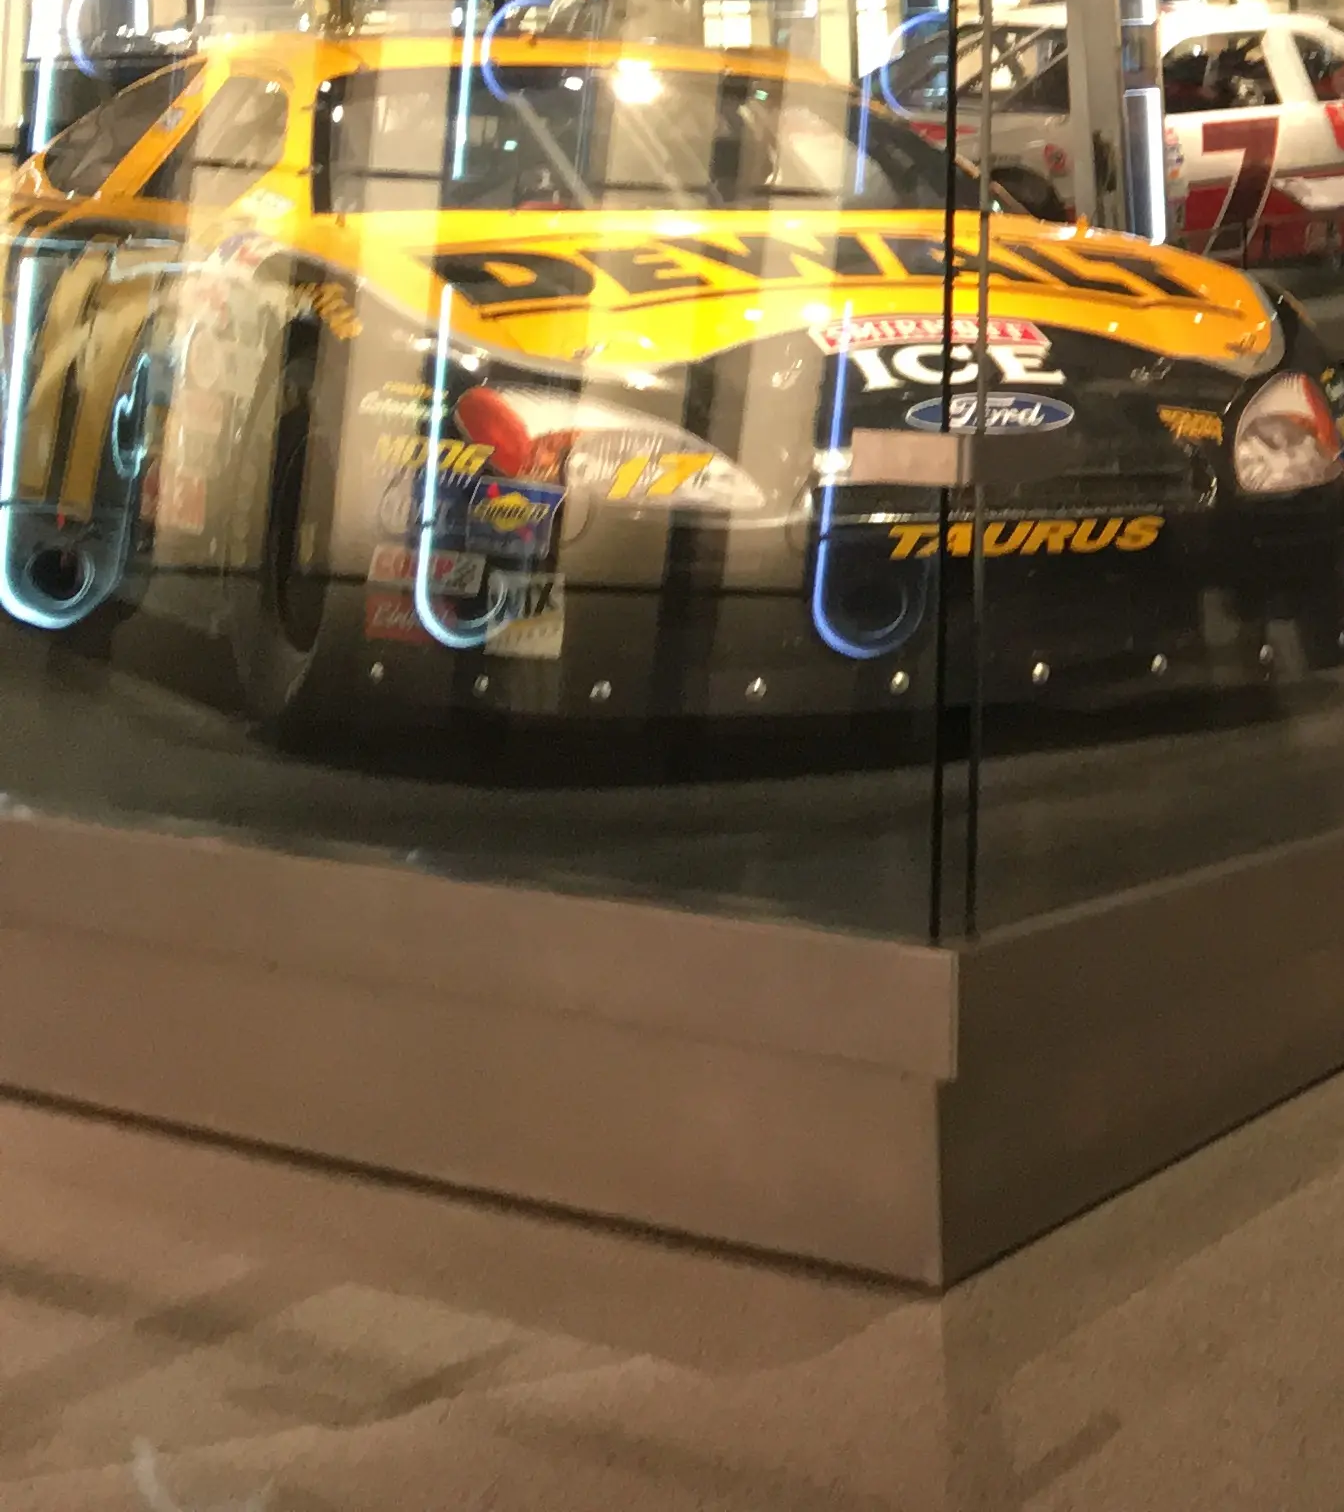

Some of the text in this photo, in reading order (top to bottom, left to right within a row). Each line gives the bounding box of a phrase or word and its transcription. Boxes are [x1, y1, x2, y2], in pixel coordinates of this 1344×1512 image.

[1202, 116, 1281, 256] 7
[851, 344, 1067, 393] ICE
[373, 434, 497, 476] MOOG
[606, 452, 715, 500] 17
[888, 514, 1165, 561] TAURUS
